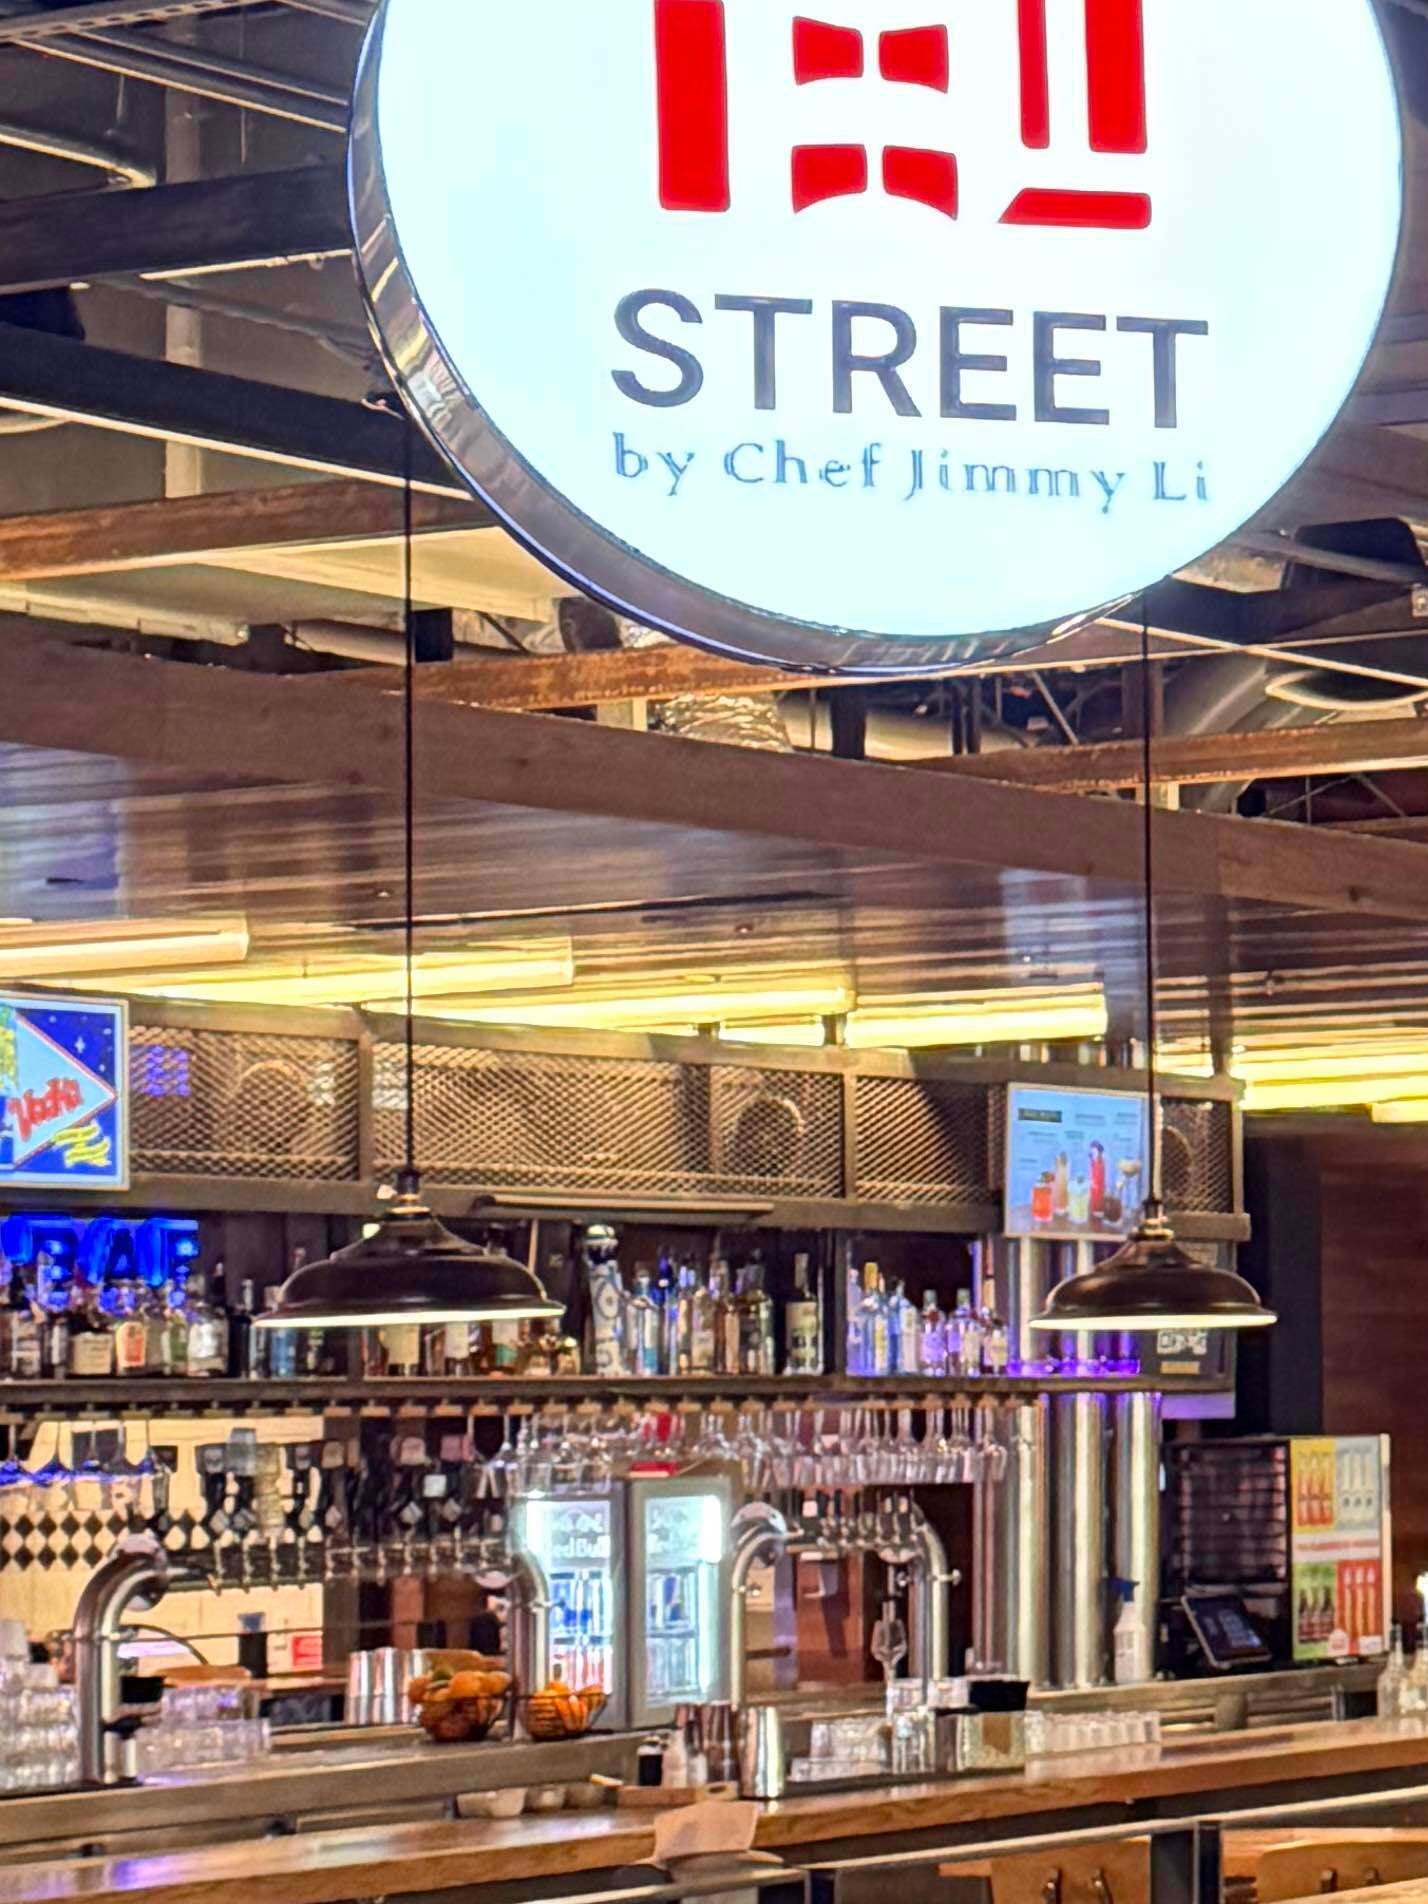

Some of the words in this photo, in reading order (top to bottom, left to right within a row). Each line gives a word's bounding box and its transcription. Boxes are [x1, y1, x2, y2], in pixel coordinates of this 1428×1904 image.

[610, 287, 1209, 429] STREET
[612, 431, 695, 496] by
[723, 440, 882, 489] Chef
[904, 448, 1126, 514] Jimmy
[1152, 460, 1209, 502] Li
